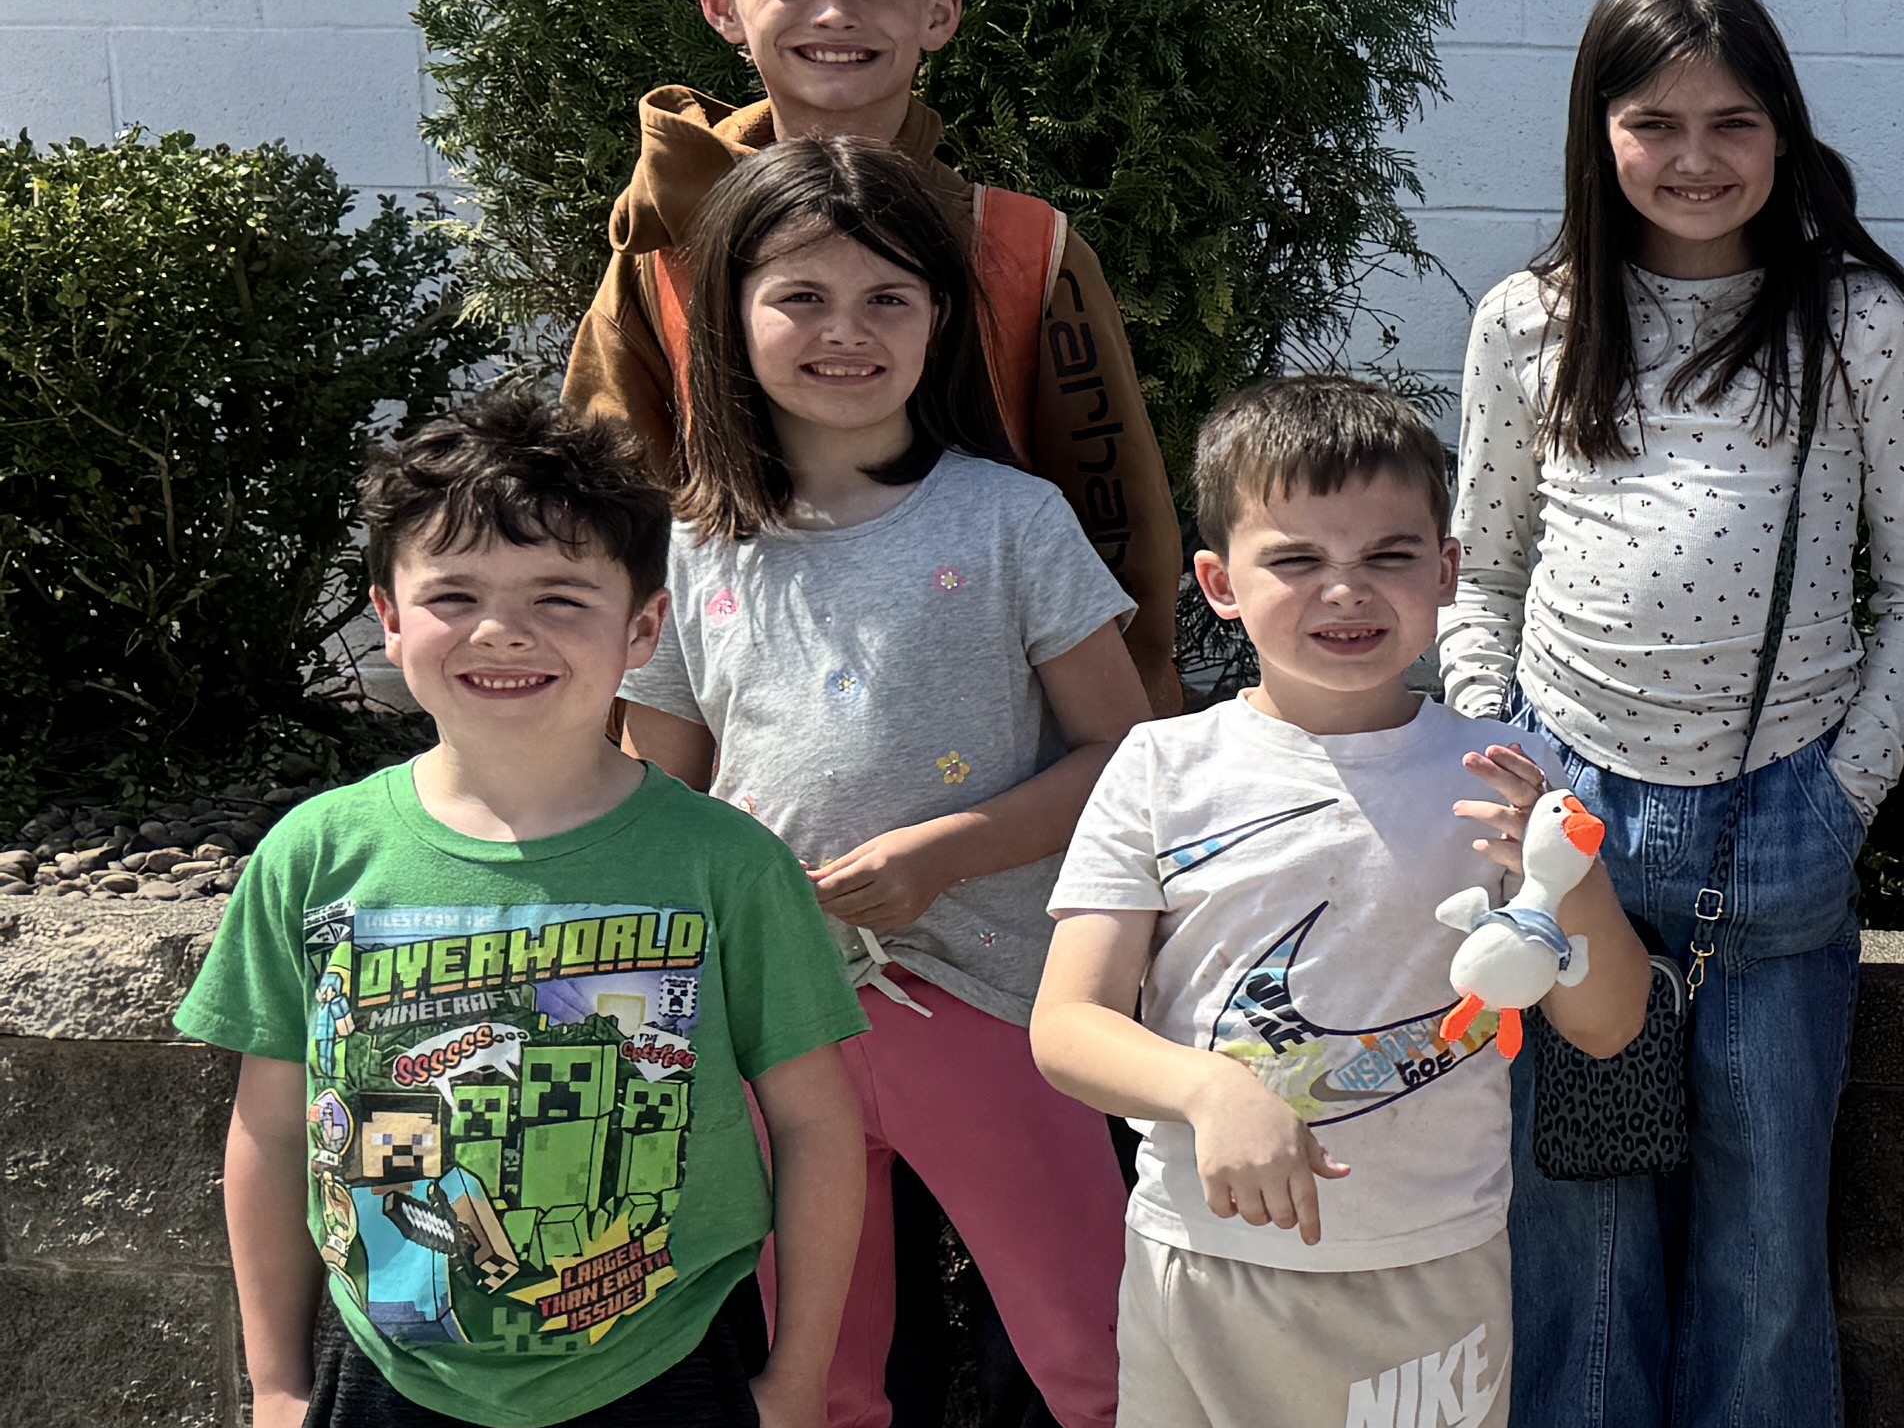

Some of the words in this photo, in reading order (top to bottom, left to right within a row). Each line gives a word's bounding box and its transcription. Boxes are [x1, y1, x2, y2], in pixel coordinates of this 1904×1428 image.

[1046, 268, 1131, 570] carhar
[356, 912, 706, 1009] OVERWORLD
[367, 988, 523, 1030] MINECRAFT
[538, 1281, 600, 1318] THAN
[603, 1248, 672, 1297] EARTH
[562, 1240, 643, 1289] LARGER
[569, 1282, 644, 1332] ISSUE!
